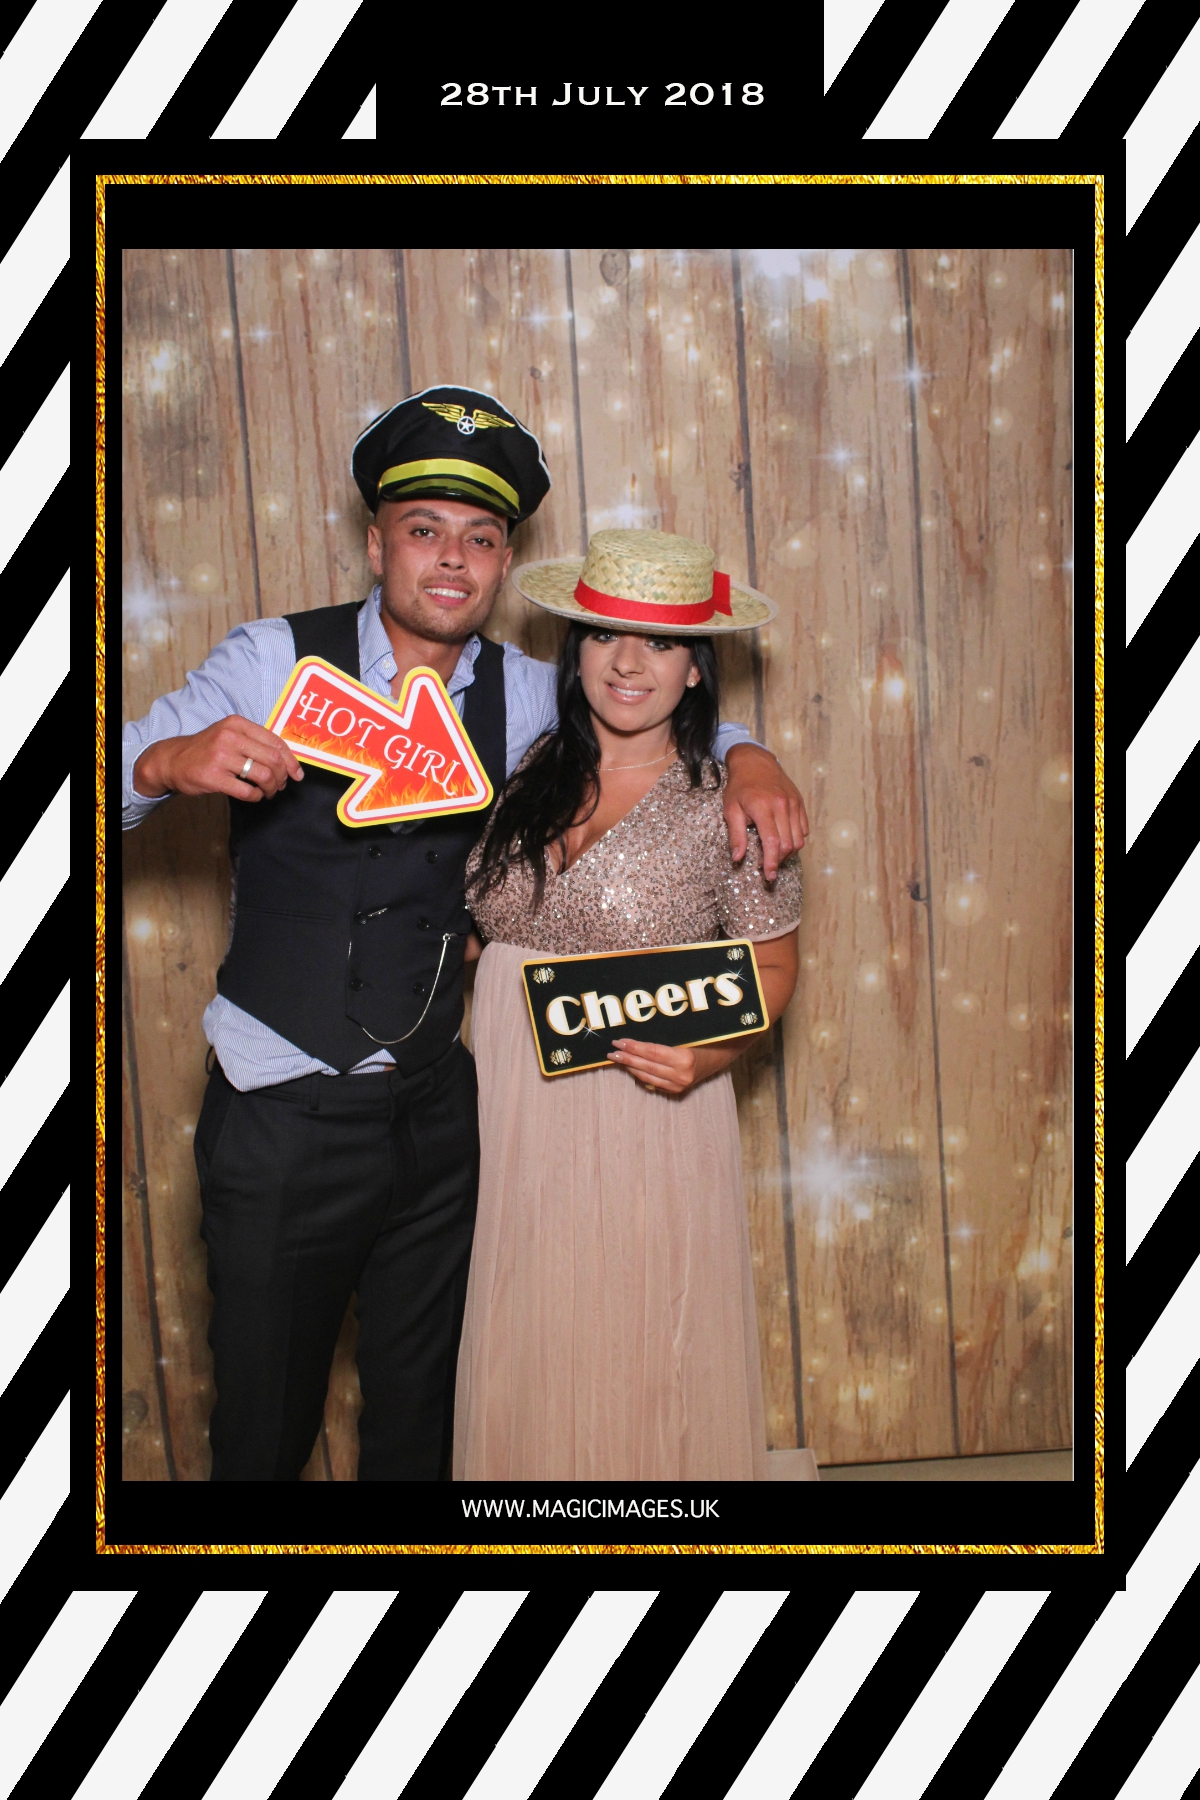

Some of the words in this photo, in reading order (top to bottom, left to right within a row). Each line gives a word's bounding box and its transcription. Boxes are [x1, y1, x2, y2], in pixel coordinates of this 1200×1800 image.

[297, 691, 385, 749] HOT
[383, 734, 461, 797] GIRL
[545, 972, 744, 1036] Cheers
